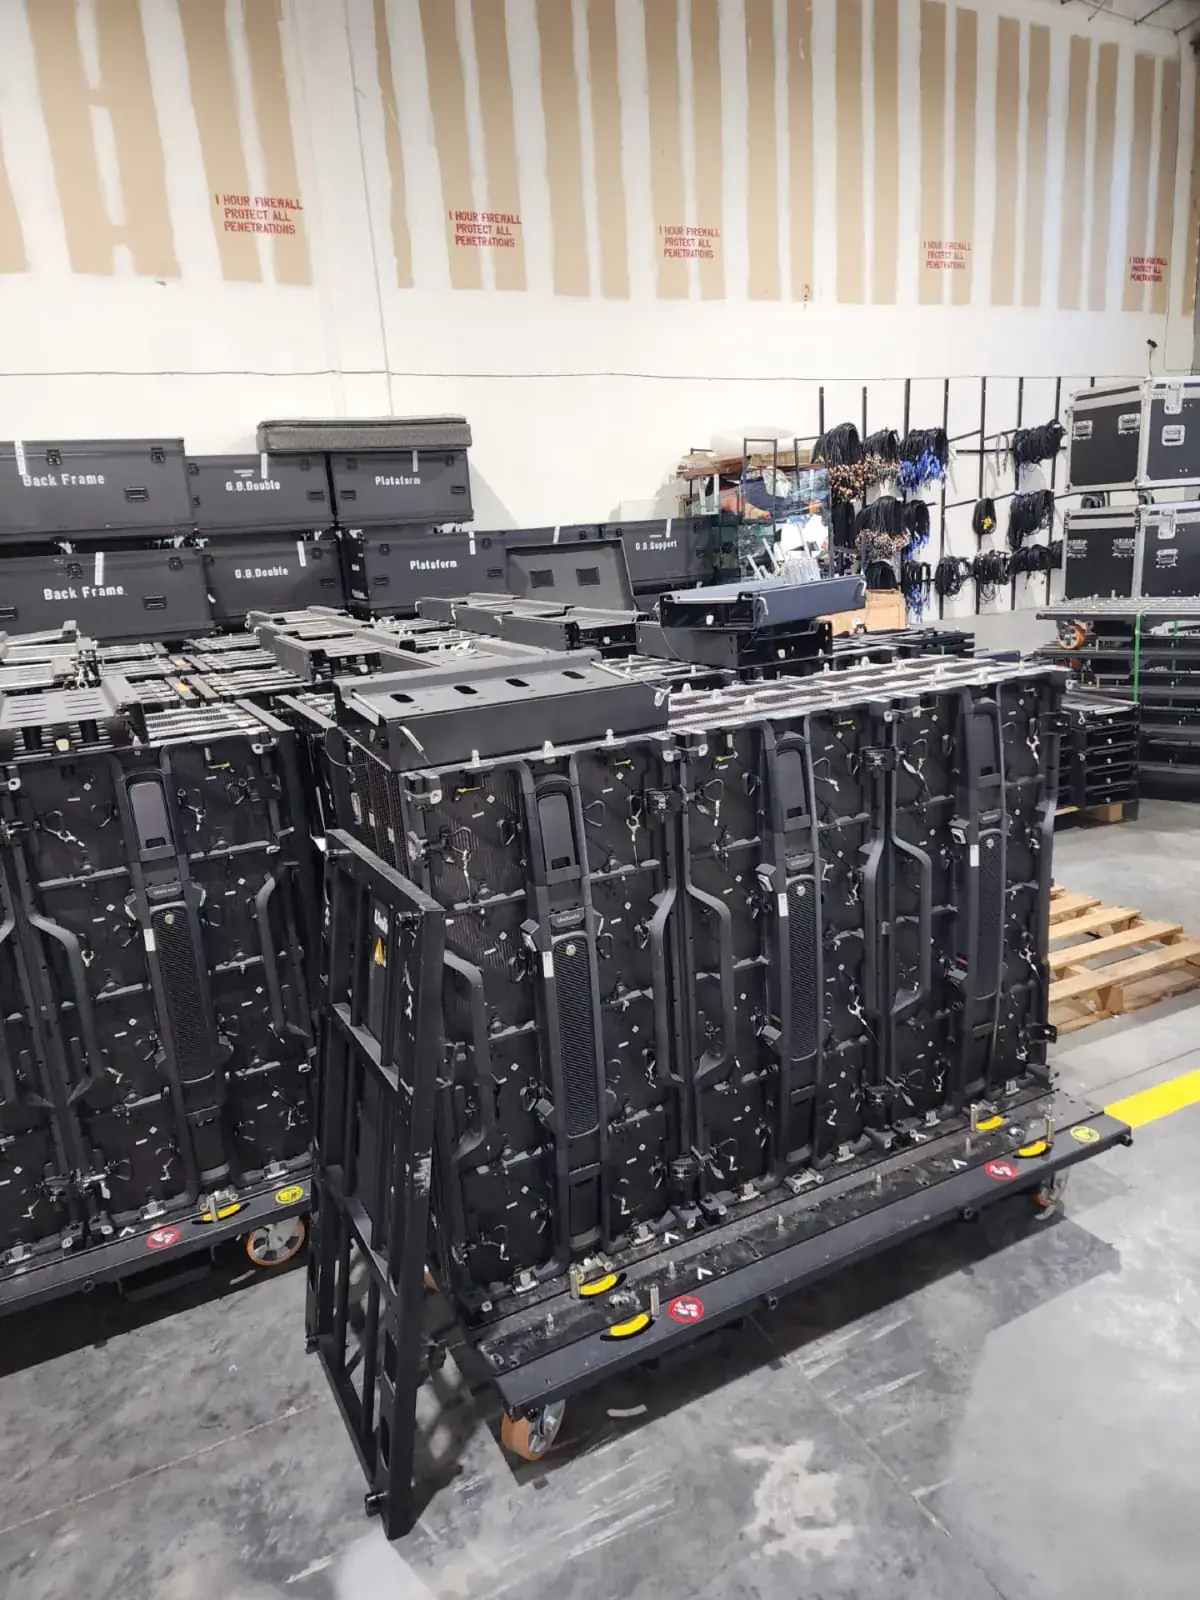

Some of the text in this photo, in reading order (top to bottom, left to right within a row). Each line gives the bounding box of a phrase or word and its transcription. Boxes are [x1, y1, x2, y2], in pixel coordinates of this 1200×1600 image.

[223, 195, 250, 207] HOUR
[255, 197, 304, 210] FIREWALL
[224, 208, 292, 222] PROTECT ALL
[455, 211, 479, 222] HOUR
[481, 212, 522, 225] FIREWALL
[223, 221, 296, 235] PENETRATIONS
[456, 223, 512, 236] PROTECT ALL
[664, 226, 684, 236] HOUR
[686, 227, 721, 237] FIREWALL
[455, 235, 515, 247] PENETRATIONS
[665, 237, 712, 248] PROTECT ALL
[663, 248, 714, 259] PENETRATIONS
[927, 251, 965, 261] PROTECT ALL
[22, 472, 105, 487] Back Frame
[43, 585, 124, 600] Back Frame
